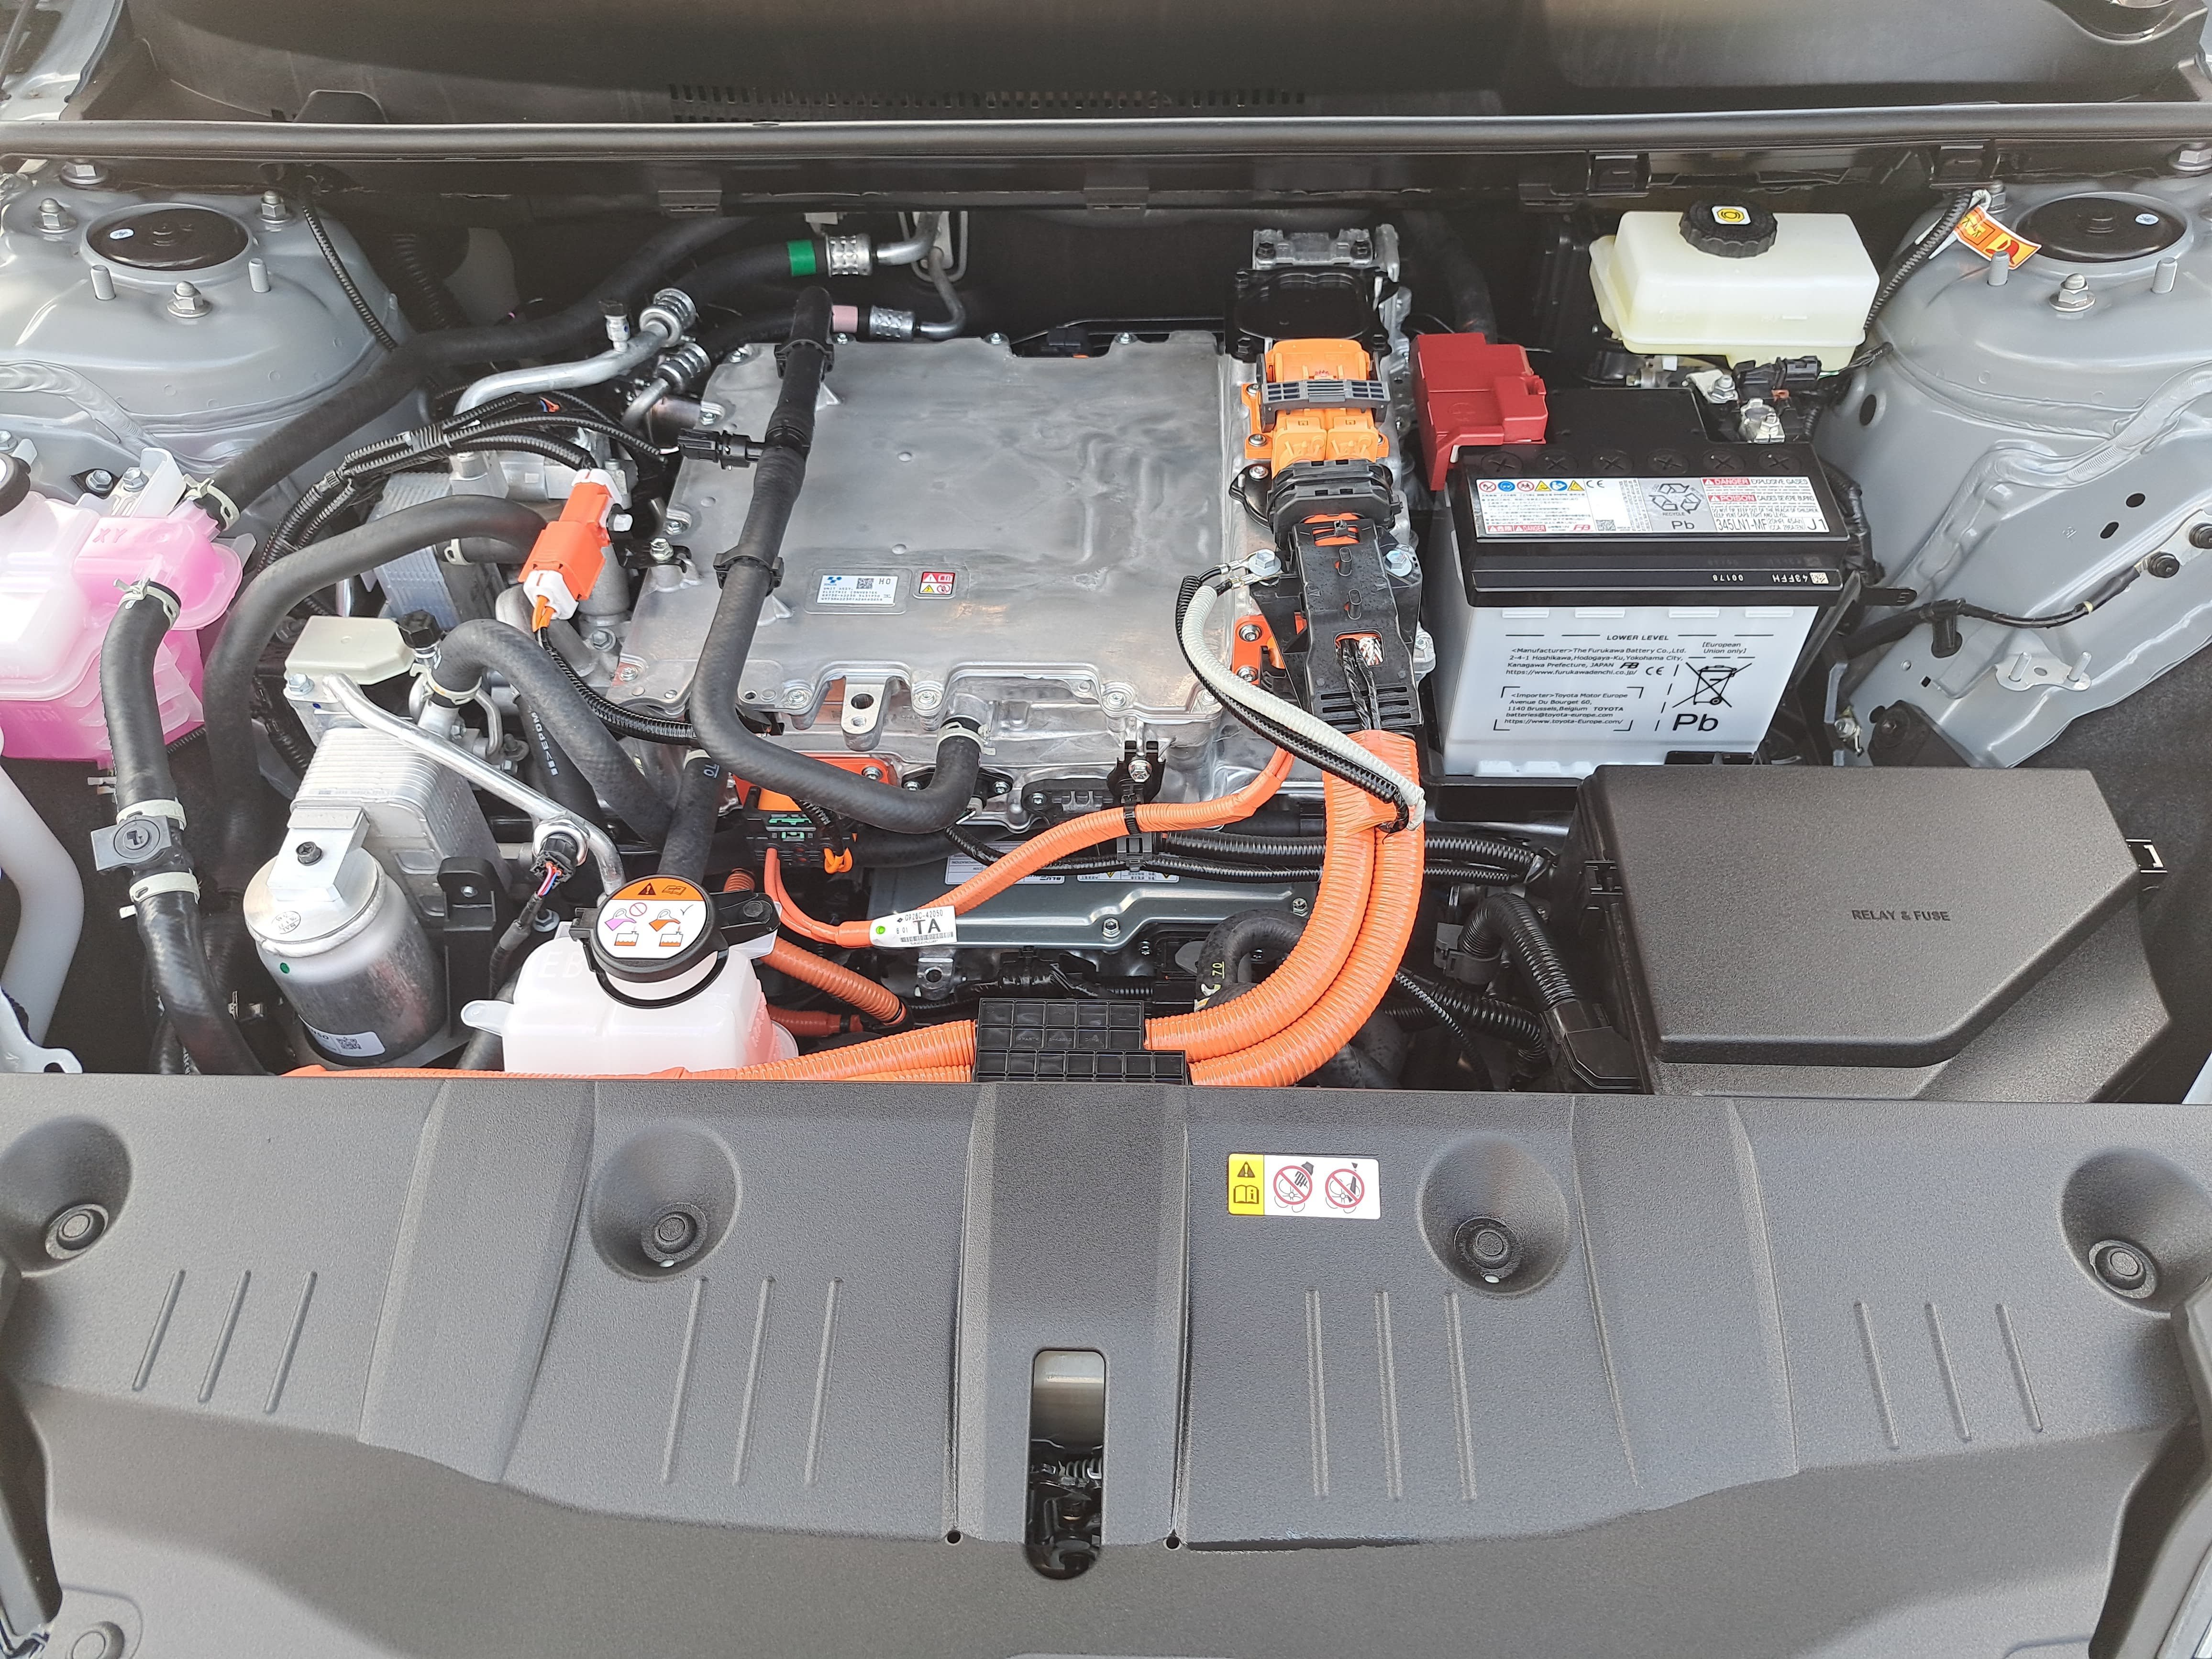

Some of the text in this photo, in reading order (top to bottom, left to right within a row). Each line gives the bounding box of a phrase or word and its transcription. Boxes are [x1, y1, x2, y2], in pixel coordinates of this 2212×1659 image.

[1671, 520, 1695, 530] Pb
[1716, 519, 1768, 531] 345LN1-MF
[92, 528, 128, 543] XY
[1672, 713, 1719, 731] Pb
[1851, 910, 1950, 921] RELAY & FUSE
[912, 918, 941, 935] TA
[1212, 962, 1223, 976] 70
